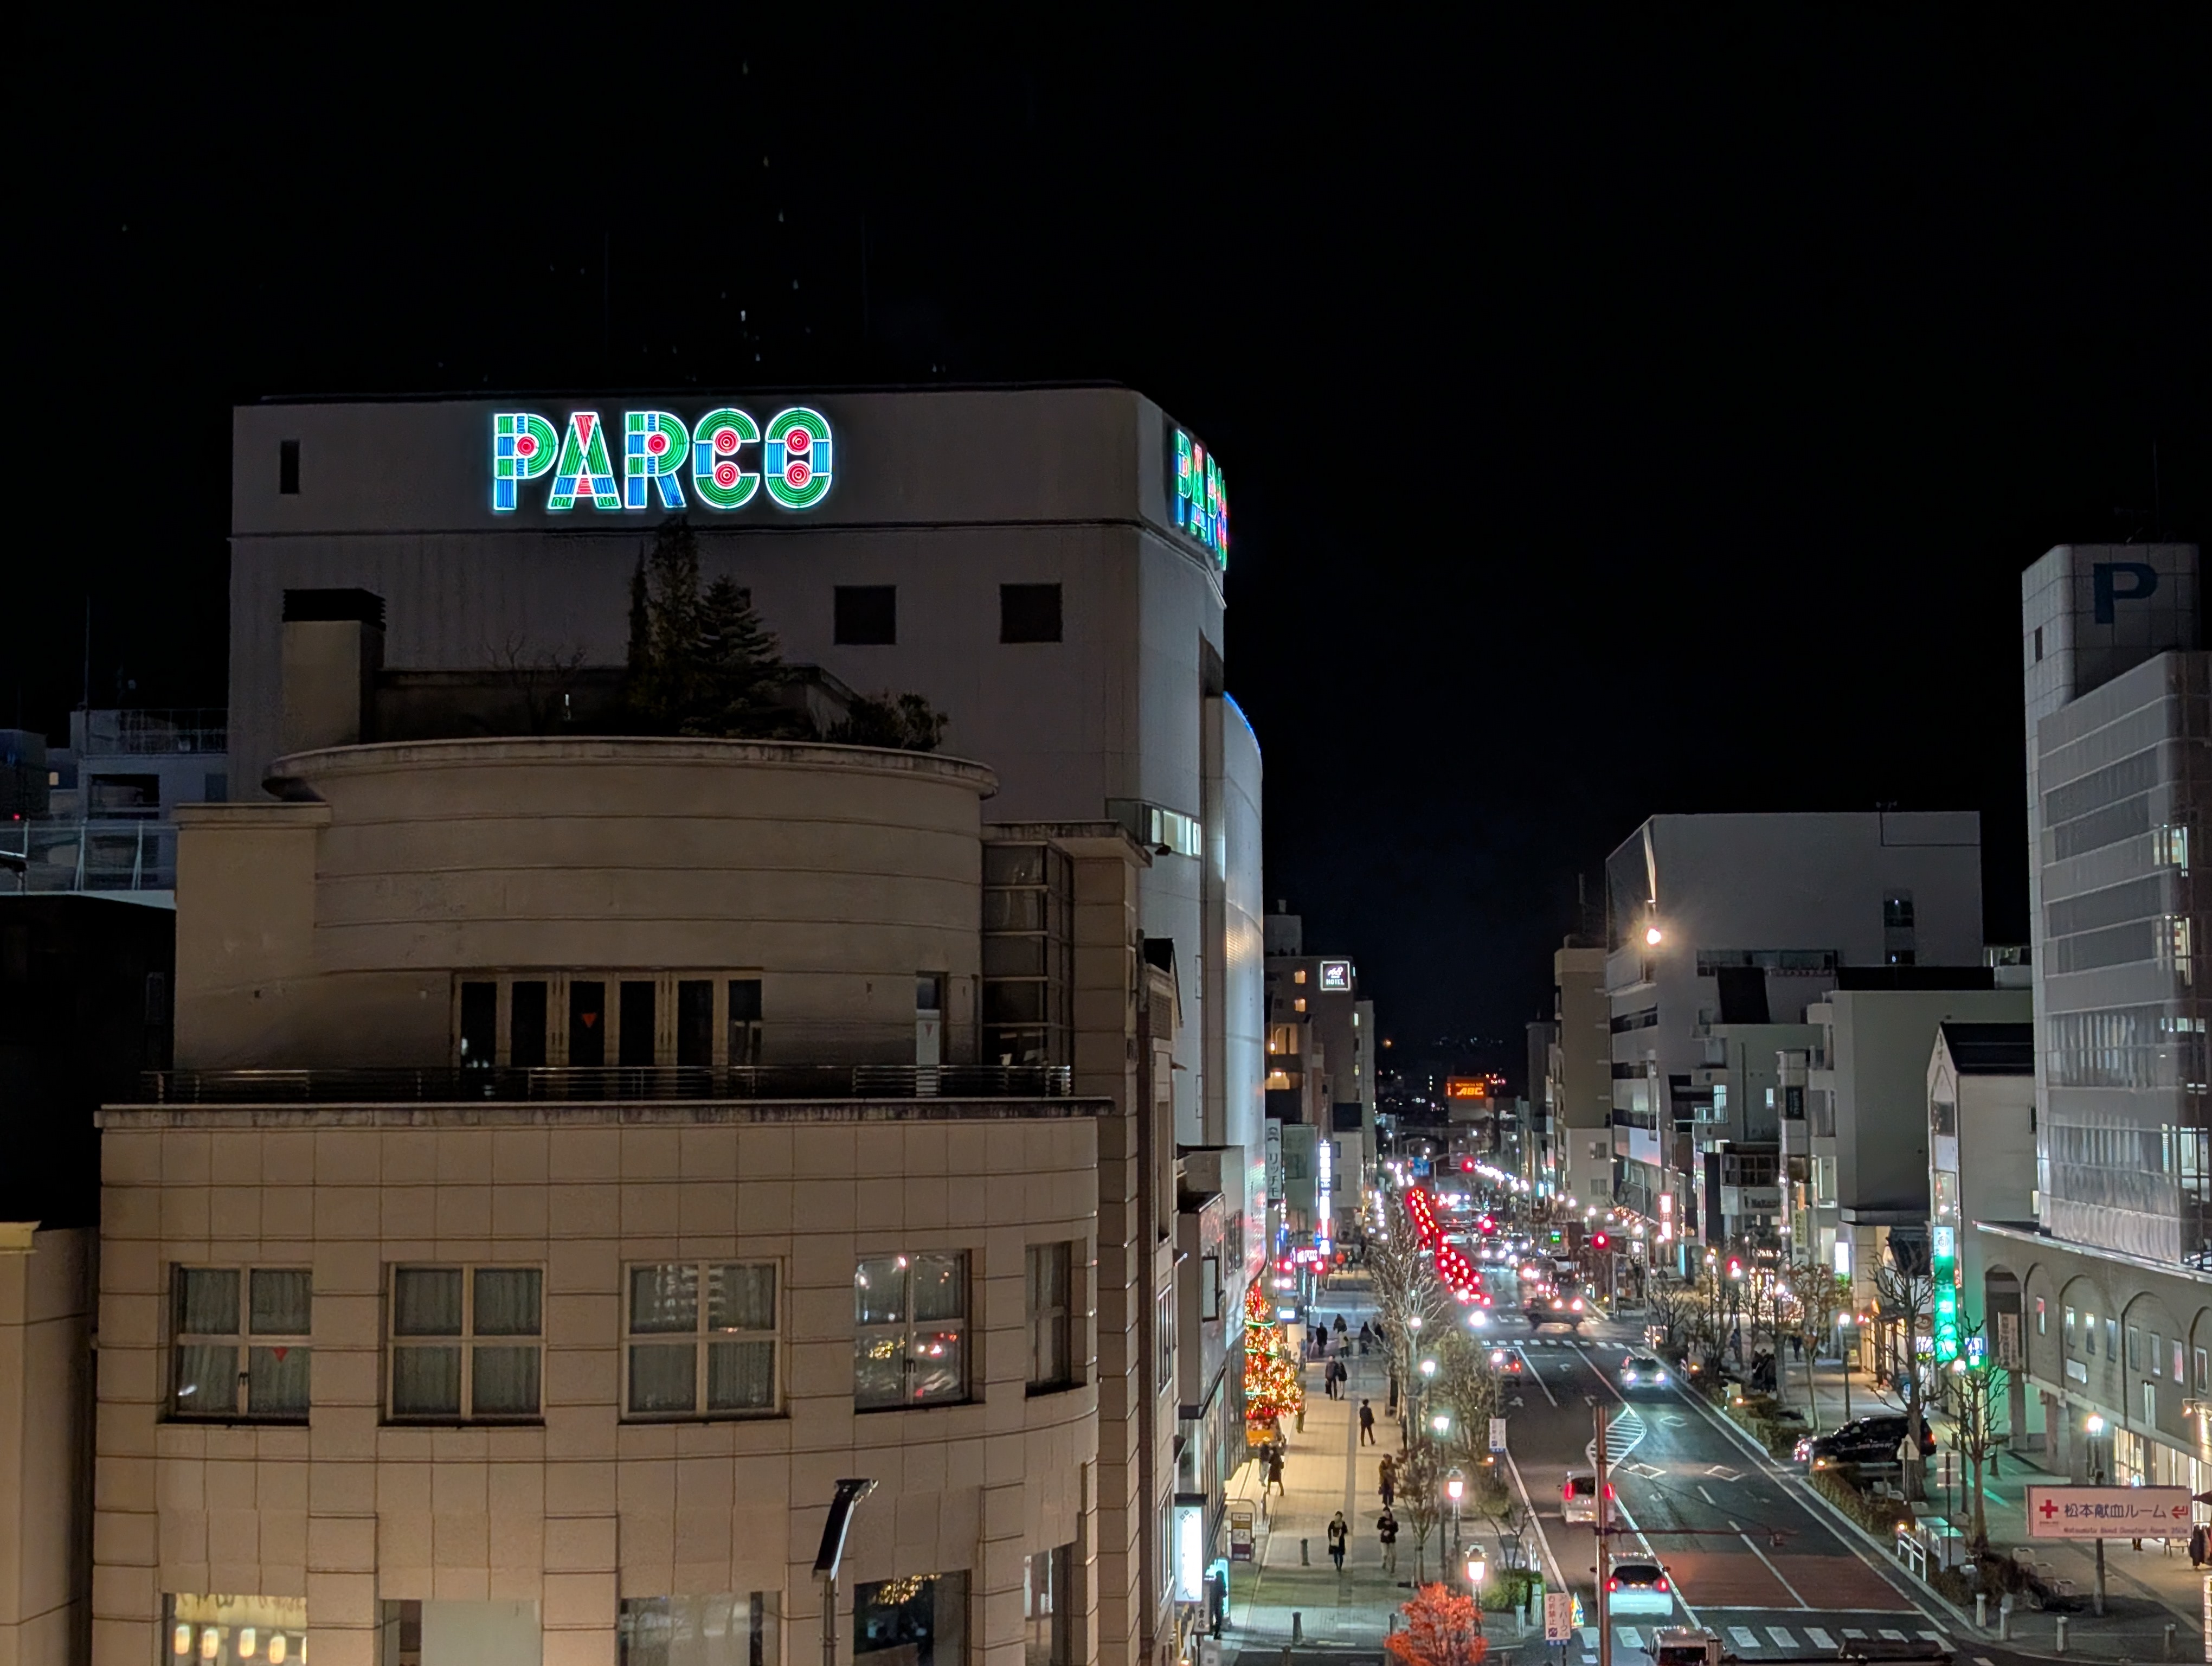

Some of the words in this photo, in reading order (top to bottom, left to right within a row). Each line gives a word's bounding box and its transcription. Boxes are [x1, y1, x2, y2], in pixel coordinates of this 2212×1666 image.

[493, 407, 832, 510] PARCO
[2093, 562, 2157, 624] P
[1456, 1087, 1484, 1095] ABC
[2065, 1503, 2166, 1518] 松本献血ルーム
